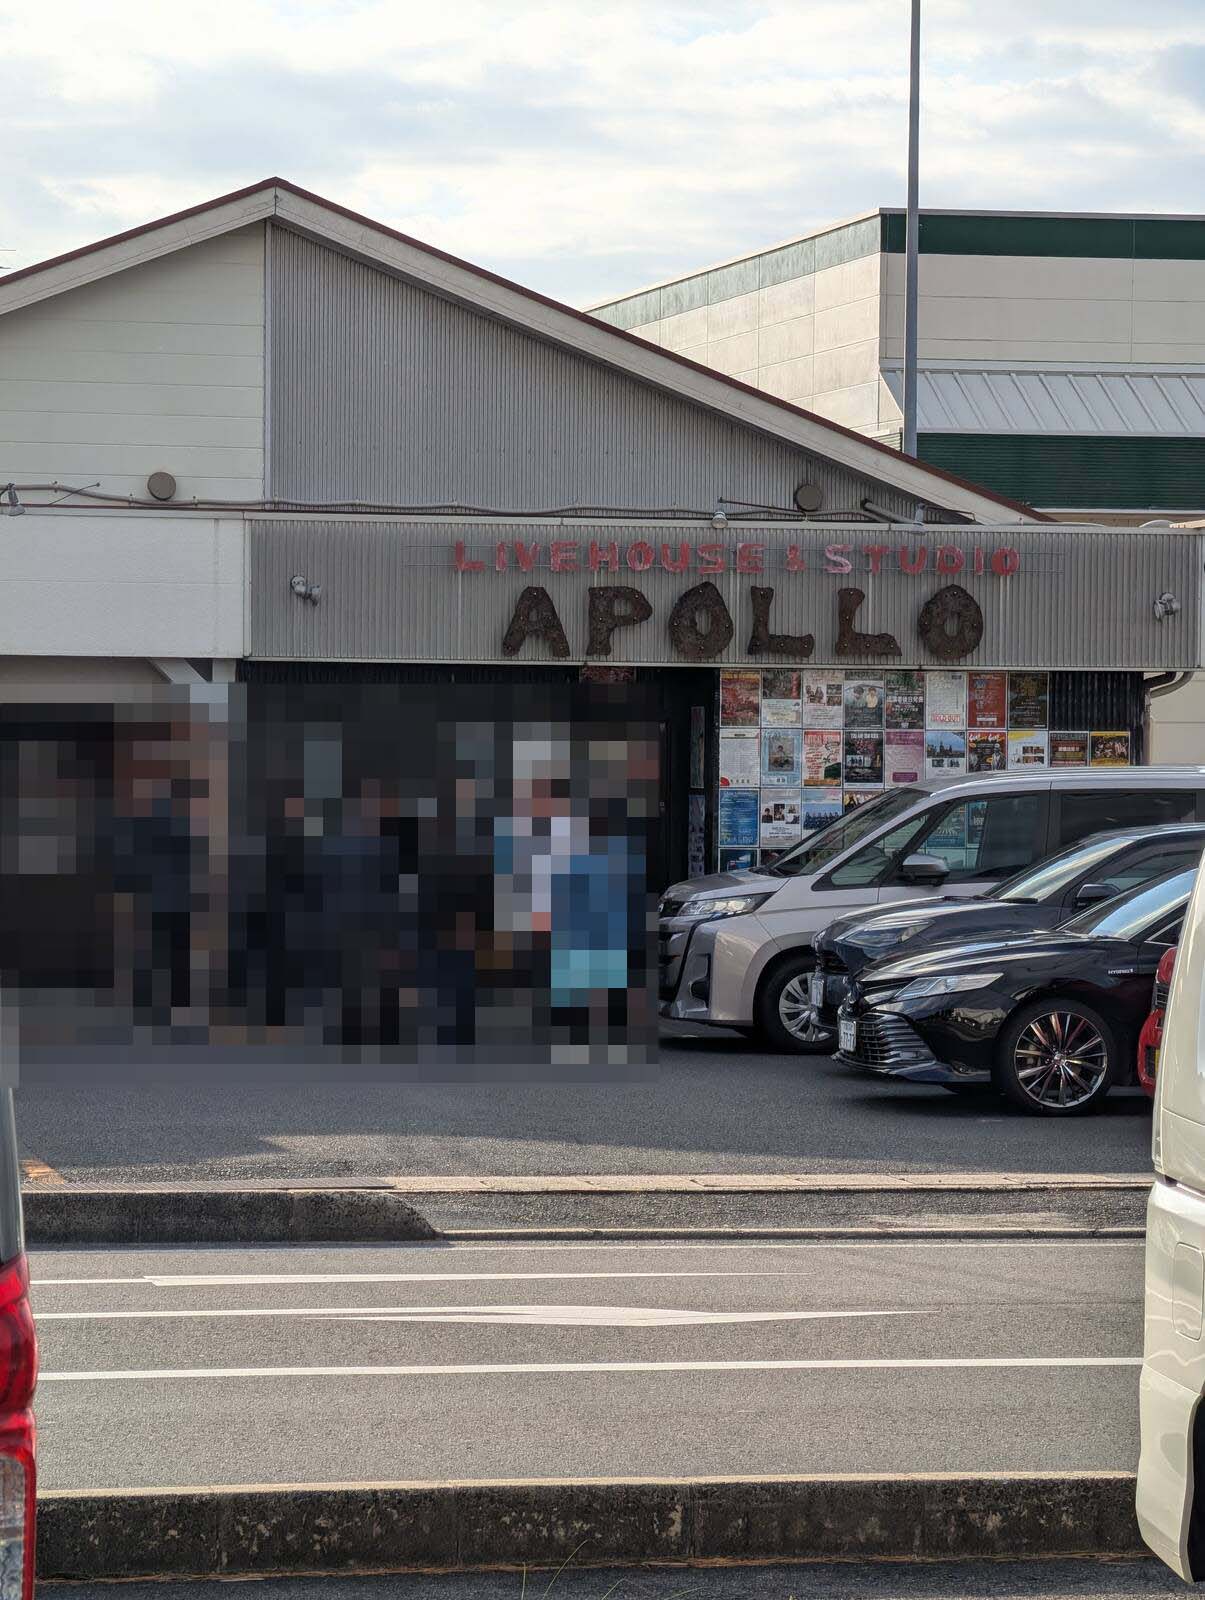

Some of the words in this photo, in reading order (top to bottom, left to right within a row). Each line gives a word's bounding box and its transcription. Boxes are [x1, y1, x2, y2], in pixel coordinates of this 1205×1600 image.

[455, 540, 767, 575] LIVEHOUSE
[786, 544, 805, 573] &
[823, 543, 1020, 576] STUDIO
[502, 581, 983, 660] APOLLO
